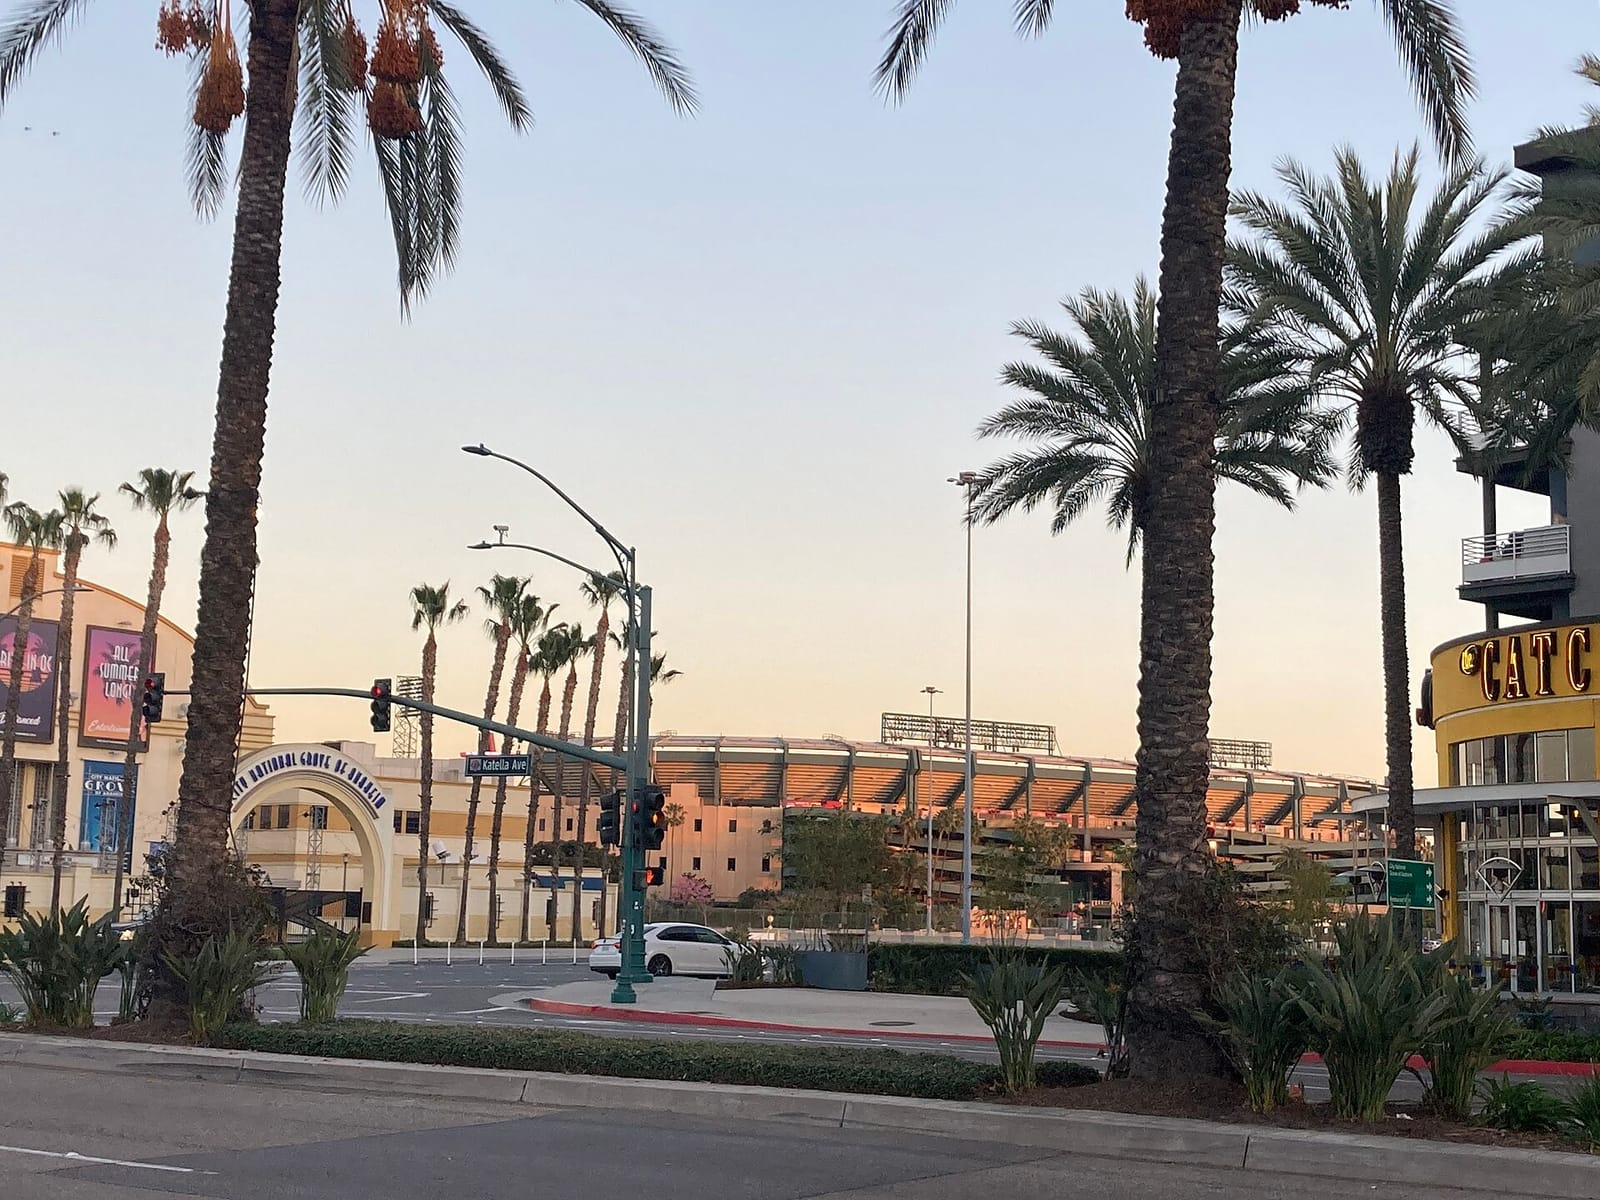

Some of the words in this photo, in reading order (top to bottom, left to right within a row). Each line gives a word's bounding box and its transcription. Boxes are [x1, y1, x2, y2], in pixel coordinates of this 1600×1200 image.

[111, 645, 130, 663] ALL
[482, 758, 510, 771] Katella
[512, 759, 527, 771] Ave
[248, 752, 297, 782] NATIONAL
[300, 752, 332, 768] GROVE
[334, 759, 348, 775] OF
[348, 768, 387, 810] ANAHEIM
